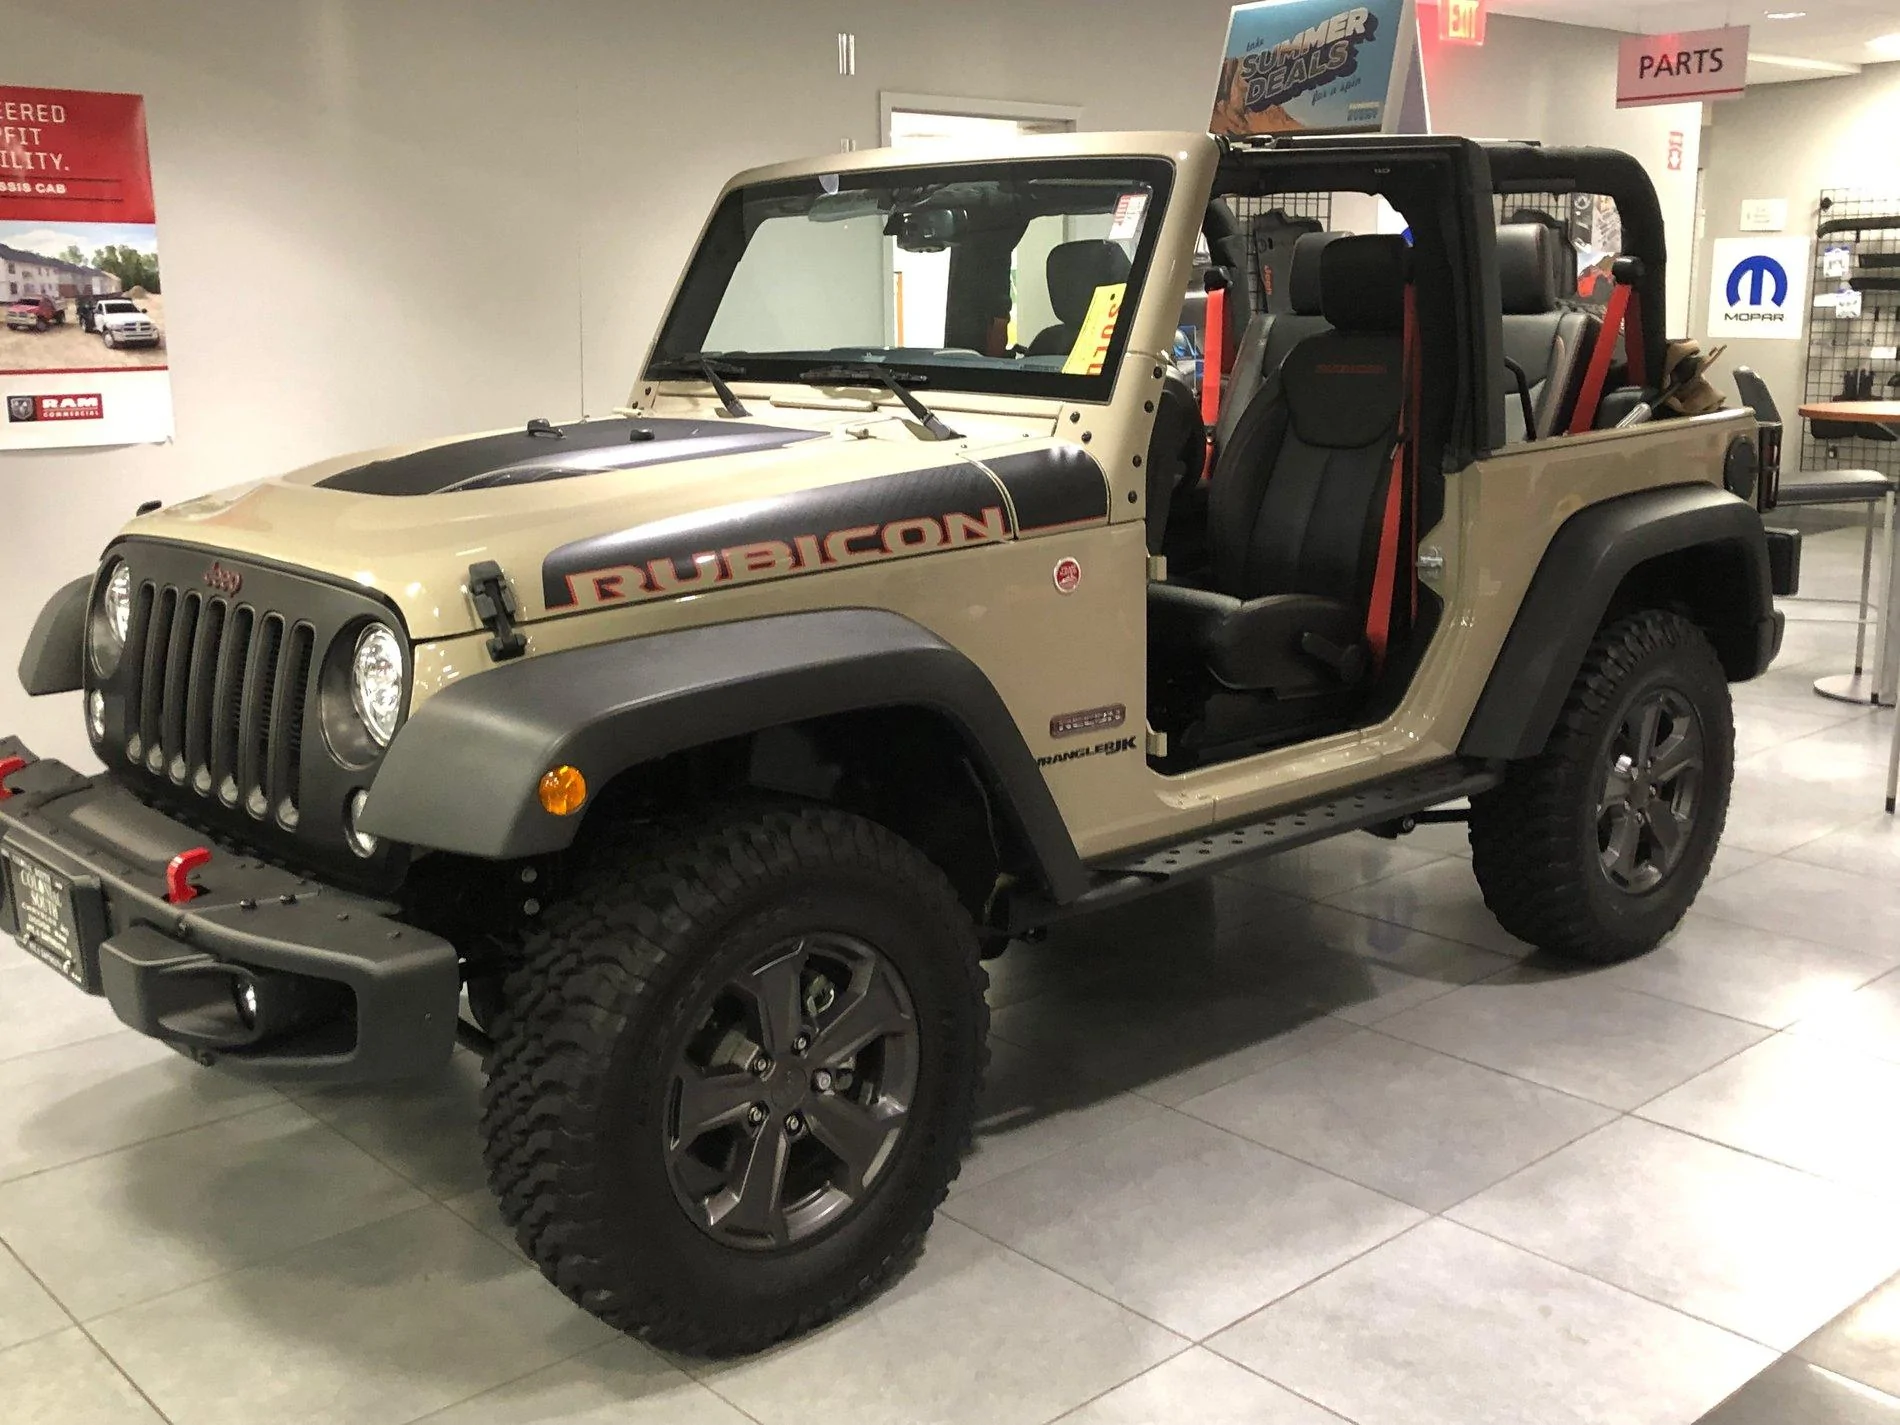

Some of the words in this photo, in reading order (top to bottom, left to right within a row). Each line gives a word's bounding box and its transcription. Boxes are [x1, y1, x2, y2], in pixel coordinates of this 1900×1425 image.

[1241, 7, 1369, 77] SUMMER
[1245, 40, 1349, 105] DEALS
[1639, 48, 1724, 79] PARTS
[0, 126, 42, 145] FIT
[35, 183, 67, 194] CAB
[1724, 313, 1784, 322] MOPAR
[42, 397, 98, 408] RAM
[43, 410, 99, 418] COMMERCIAL
[565, 506, 1007, 608] RUBICON
